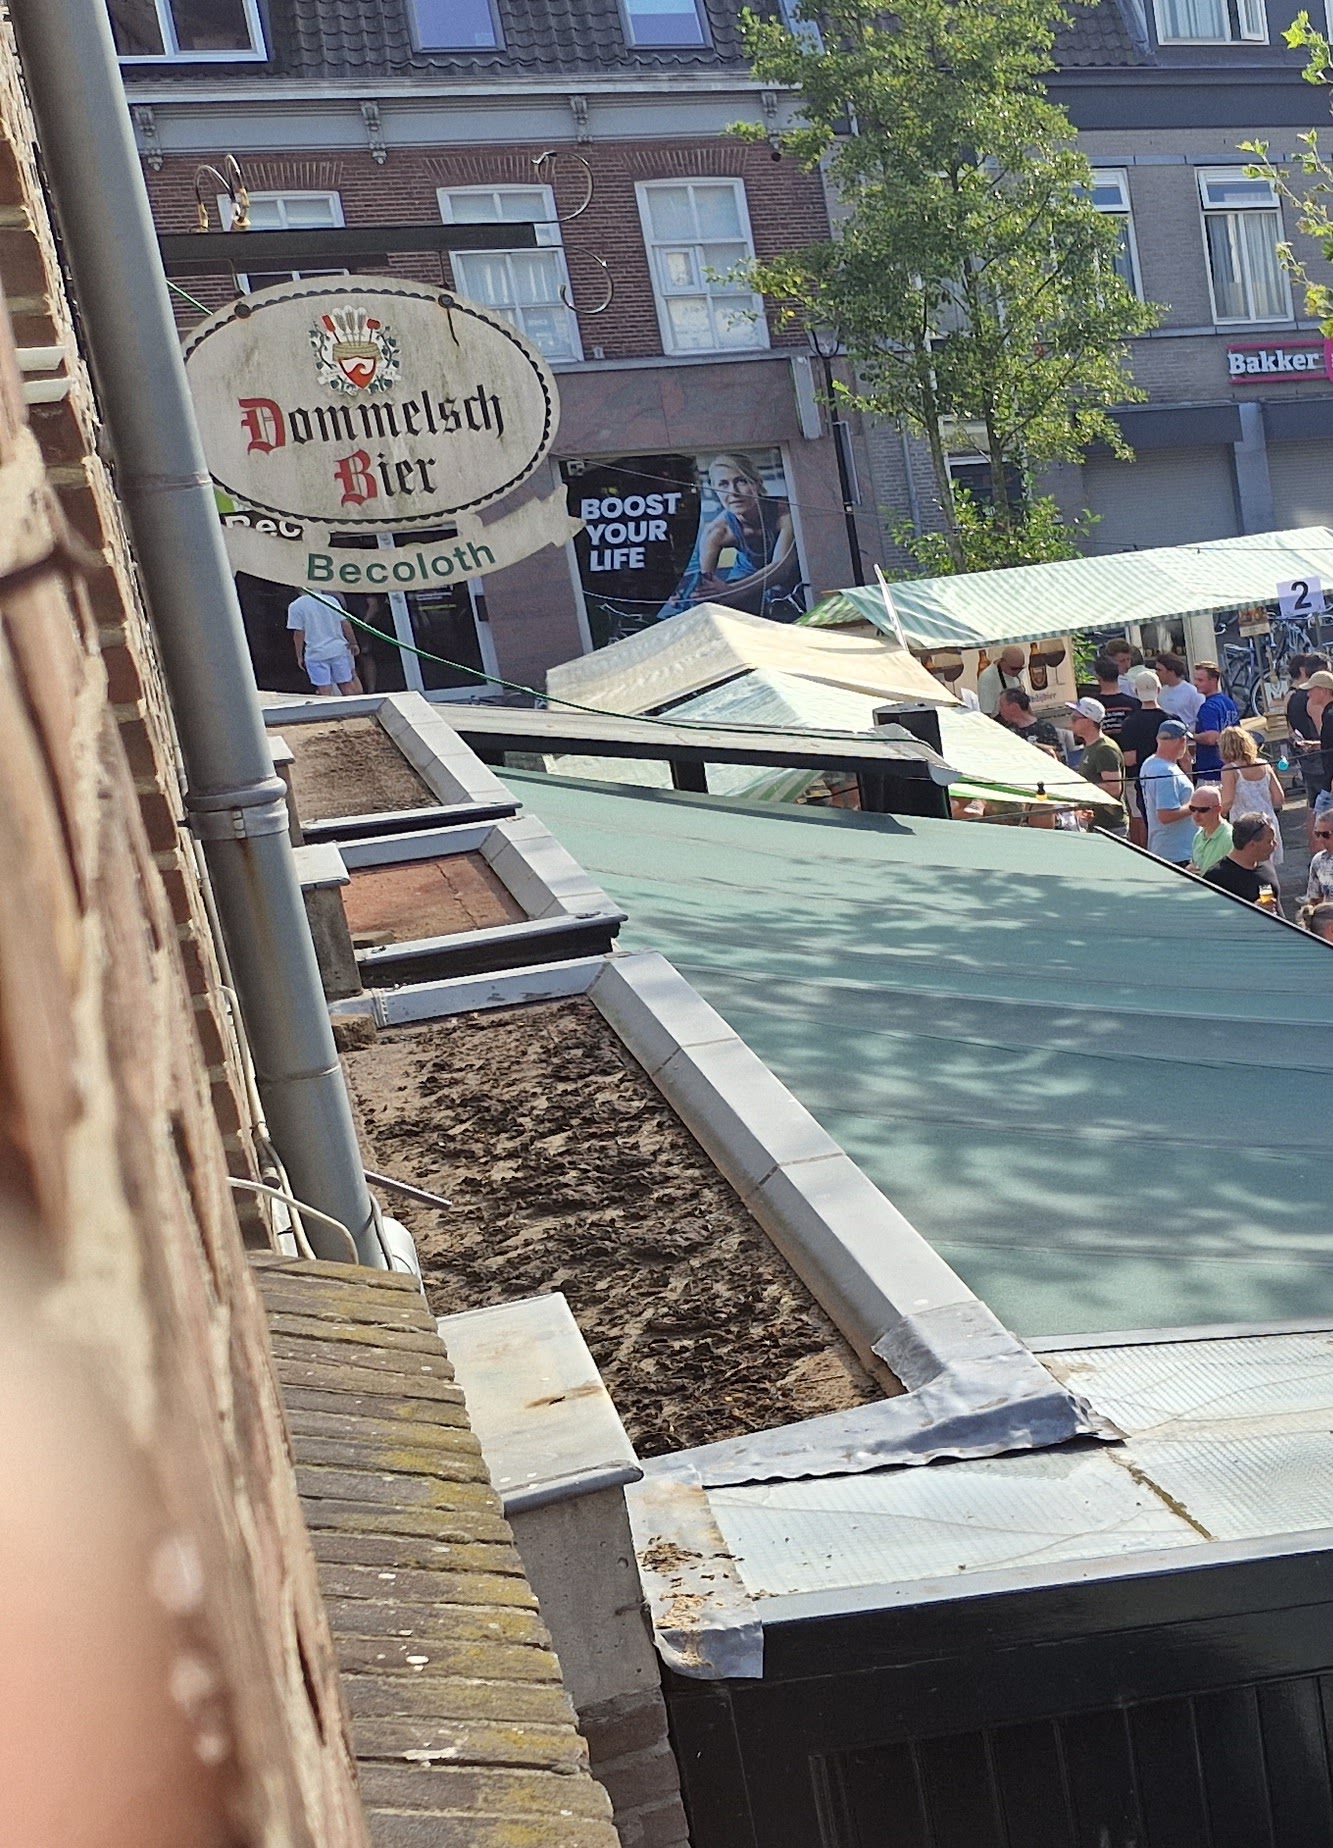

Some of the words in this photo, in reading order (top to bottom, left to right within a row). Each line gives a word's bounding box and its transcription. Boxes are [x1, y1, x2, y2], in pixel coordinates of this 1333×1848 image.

[1228, 350, 1320, 375] Bakker
[238, 384, 505, 455] Dommelsch
[334, 448, 437, 507] Bier
[581, 492, 682, 520] BOOST
[586, 520, 668, 546] YOUR
[307, 542, 496, 584] Becoloth
[590, 547, 645, 572] LIFE
[1290, 581, 1312, 611] 2
